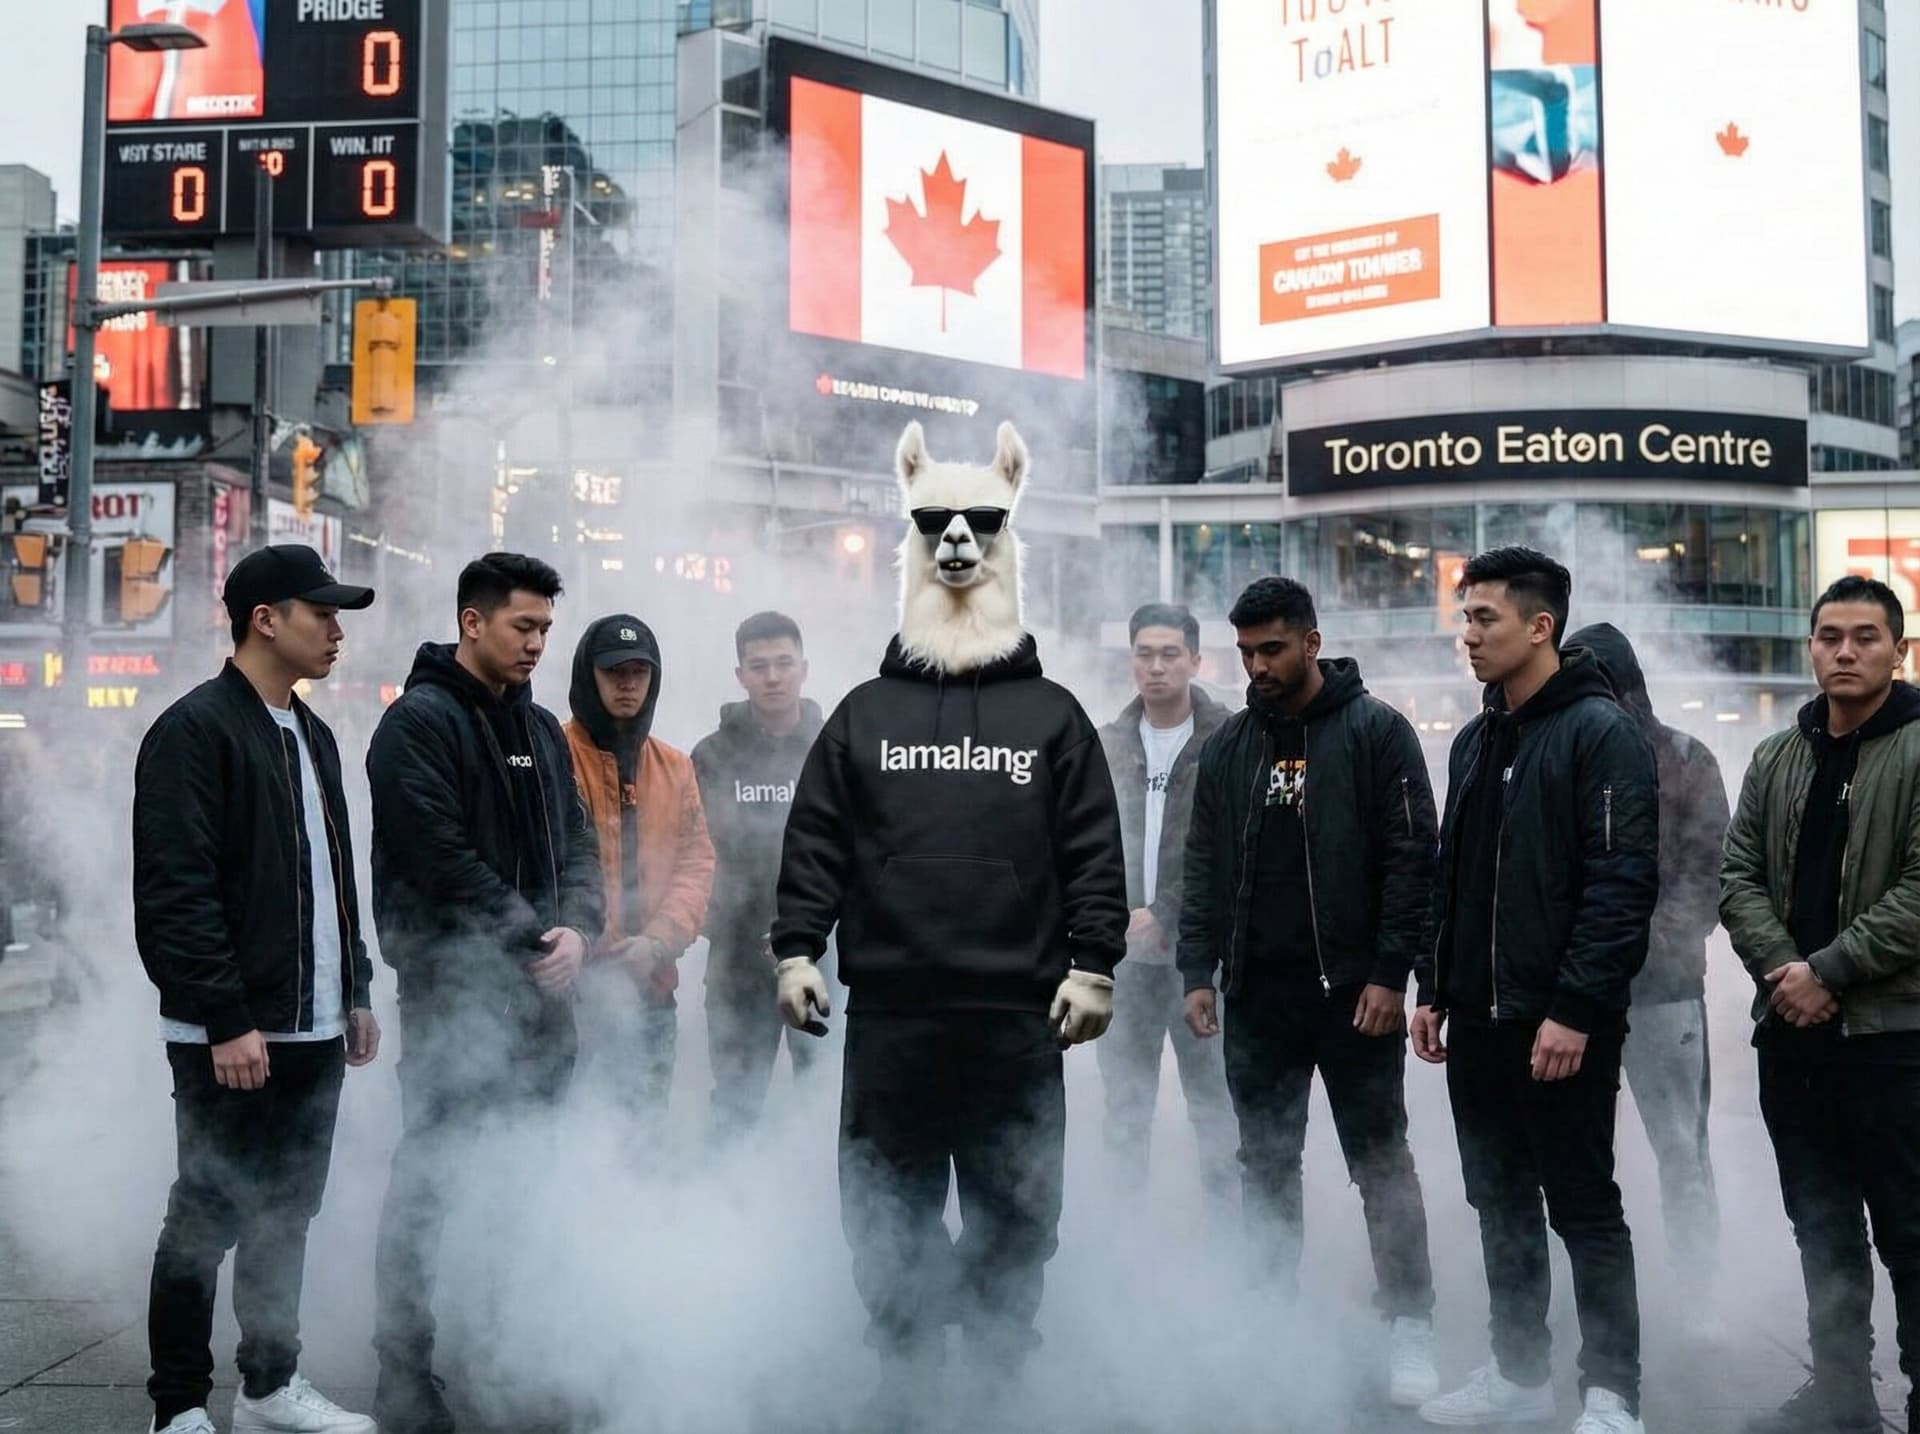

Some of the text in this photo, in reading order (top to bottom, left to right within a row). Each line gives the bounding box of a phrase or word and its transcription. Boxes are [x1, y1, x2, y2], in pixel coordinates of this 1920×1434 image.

[297, 0, 384, 22] PRIDGE
[363, 31, 400, 95] 0
[152, 142, 207, 161] STARE
[173, 167, 205, 221] 0
[362, 160, 395, 215] 0
[1325, 424, 1773, 475] Toronto Eaton Centre
[880, 736, 1038, 785] lamalang
